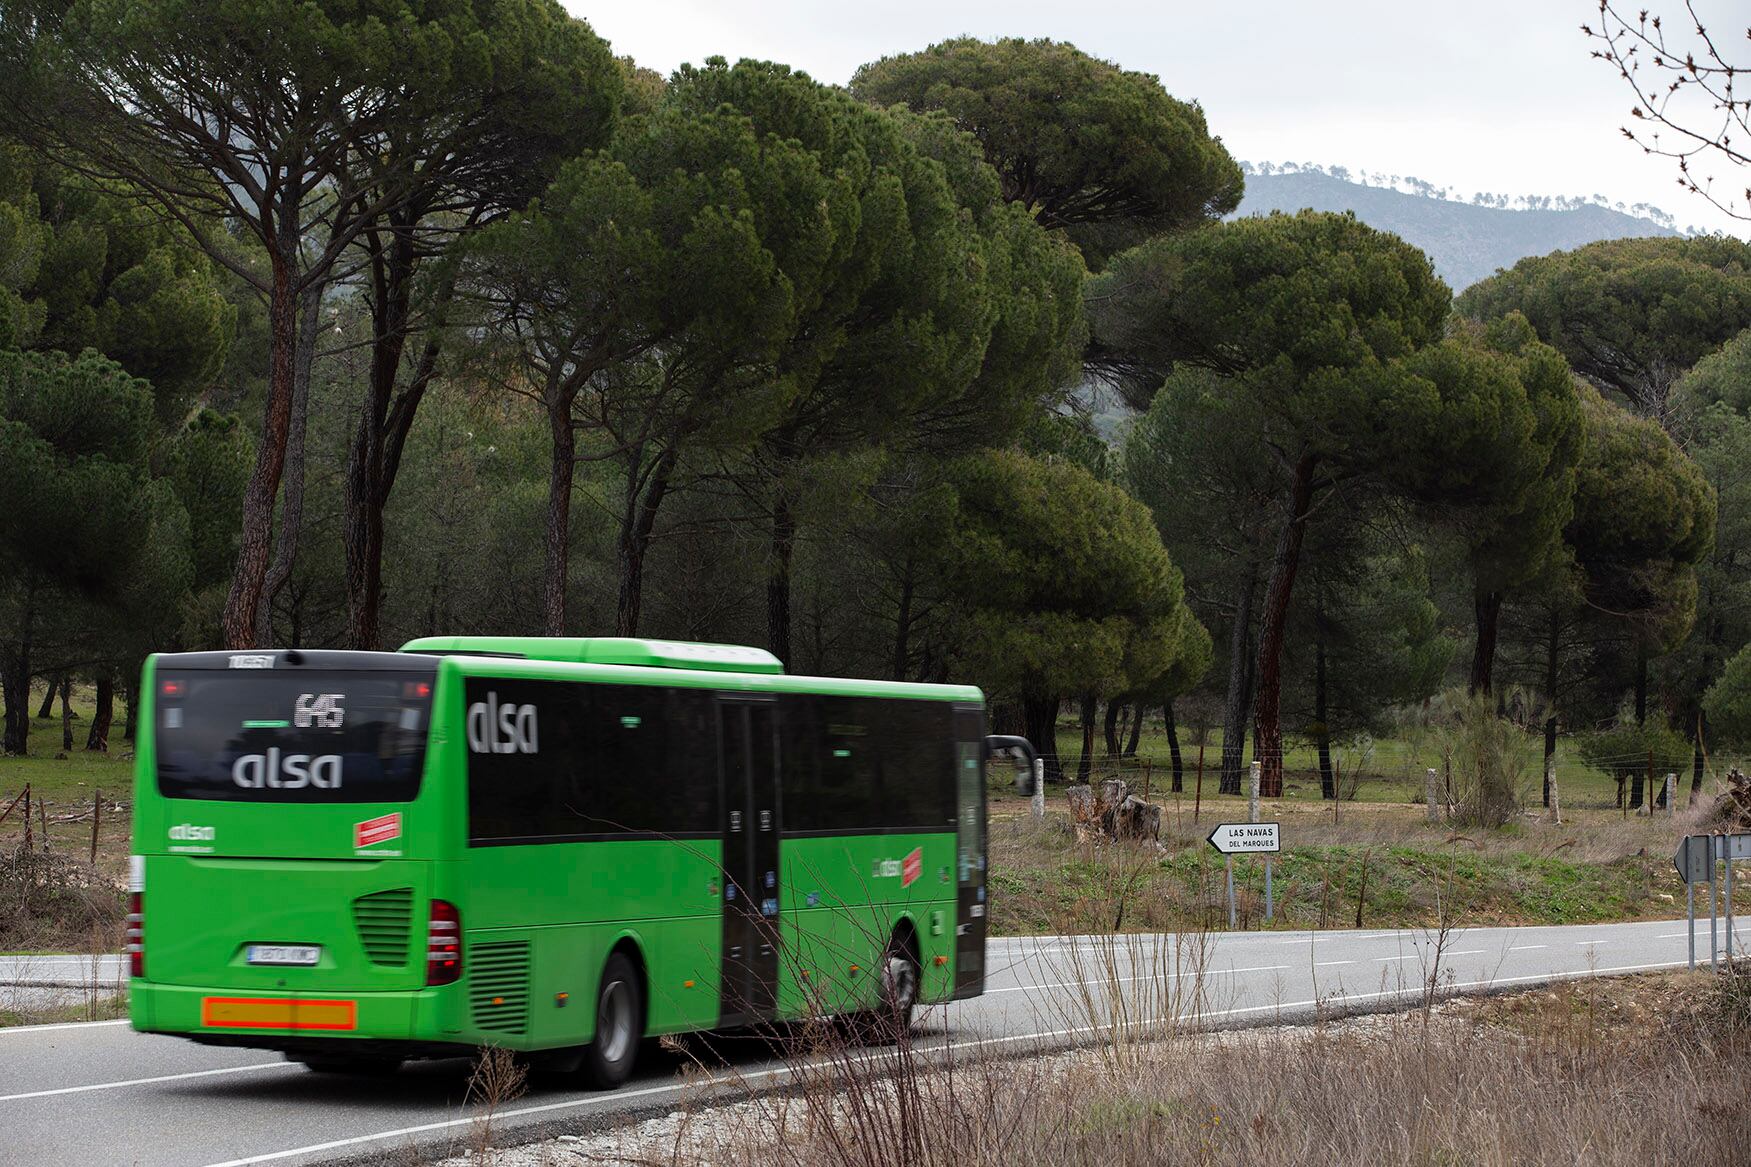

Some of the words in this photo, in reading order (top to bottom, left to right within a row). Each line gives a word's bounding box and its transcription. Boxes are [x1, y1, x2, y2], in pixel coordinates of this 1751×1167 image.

[294, 693, 345, 728] 645
[467, 691, 539, 754] alsa
[232, 747, 344, 788] alsa
[168, 823, 216, 840] alsa
[1229, 829, 1244, 837] LAS
[1247, 828, 1273, 837] NAVAS
